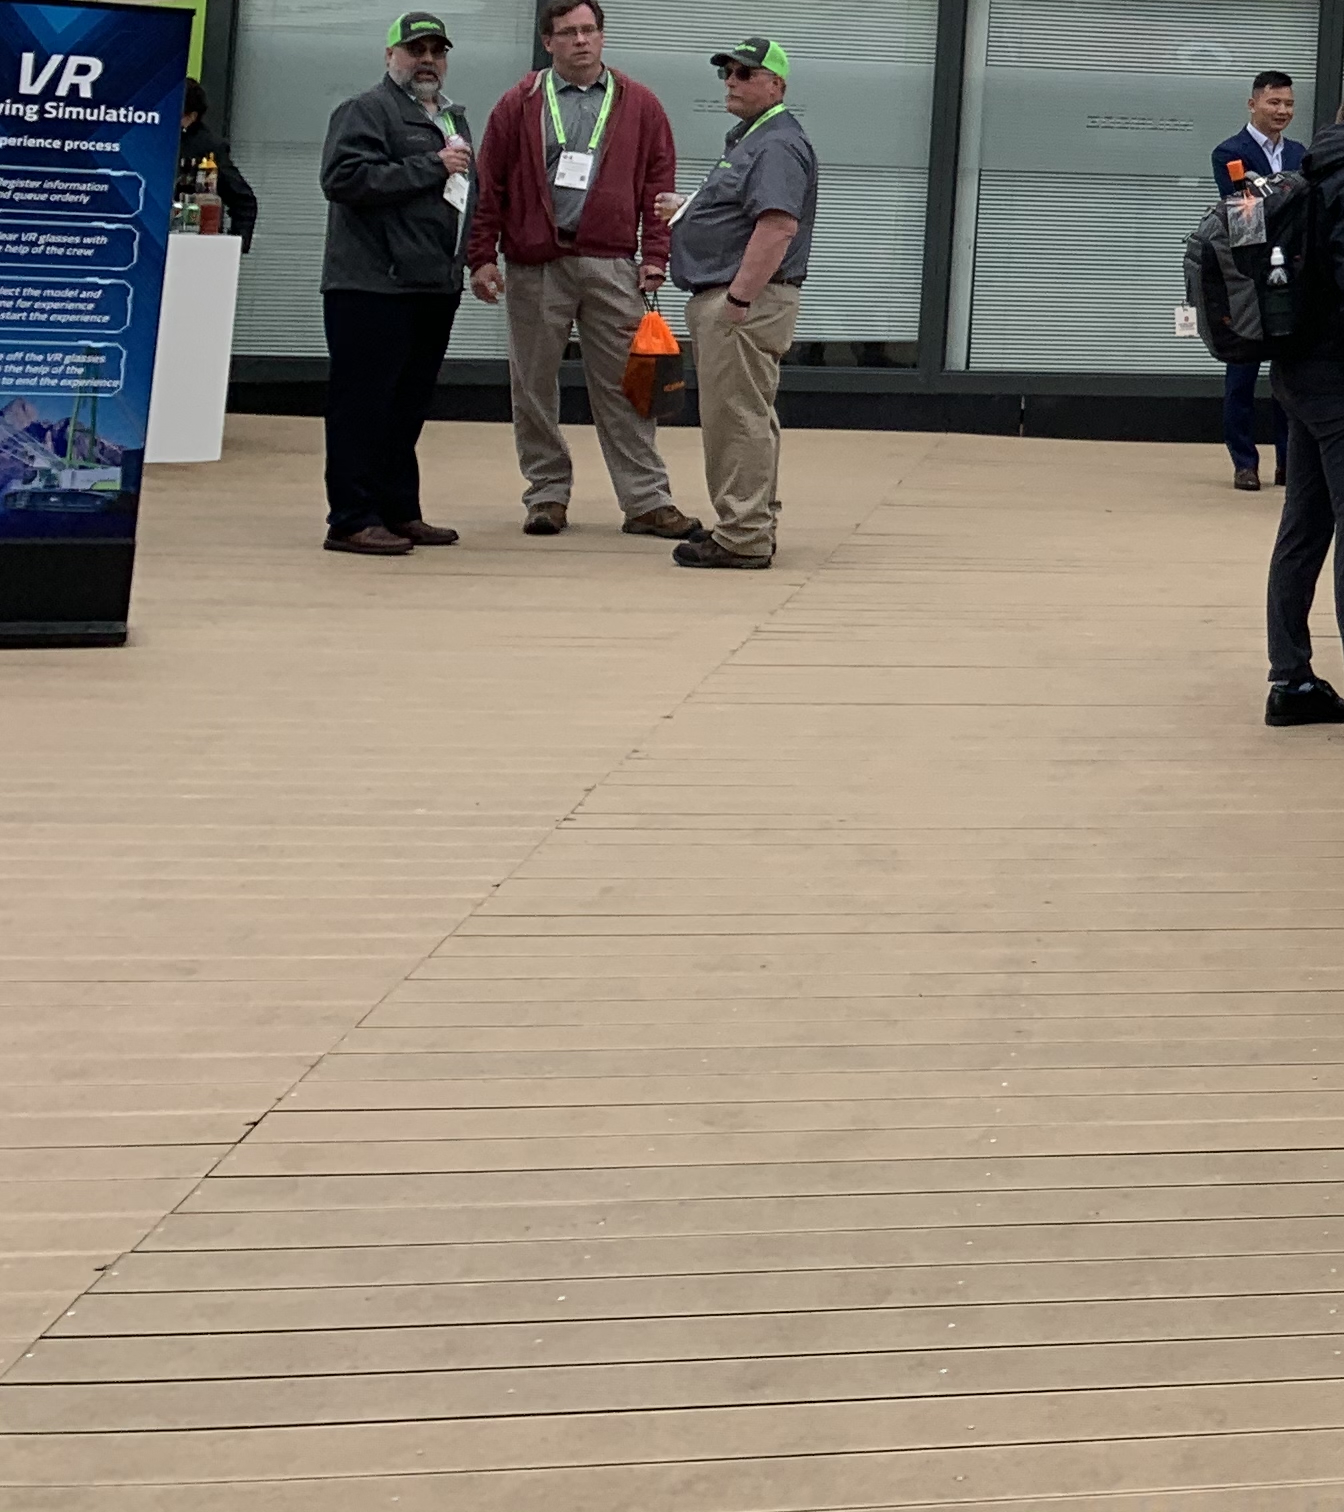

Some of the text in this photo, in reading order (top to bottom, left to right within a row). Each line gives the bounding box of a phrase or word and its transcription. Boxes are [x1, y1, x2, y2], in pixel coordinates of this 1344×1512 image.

[19, 52, 104, 99] VR
[44, 101, 160, 125] Simulation
[0, 135, 120, 152] perience process
[44, 179, 109, 192] information
[12, 191, 49, 204] queue
[50, 193, 90, 205] orderly
[0, 232, 108, 246] ear VR glasses with
[5, 245, 95, 257] help of the crew
[22, 288, 42, 297] the
[43, 288, 79, 299] model
[79, 289, 103, 299] and
[15, 299, 32, 308] for
[34, 301, 95, 312] experience
[29, 313, 48, 322] the
[49, 313, 111, 324] experience
[5, 352, 107, 365] off the VR glasses
[4, 364, 84, 375] the help of the
[15, 377, 38, 386] end
[39, 377, 58, 386] the
[60, 378, 121, 389] experience
